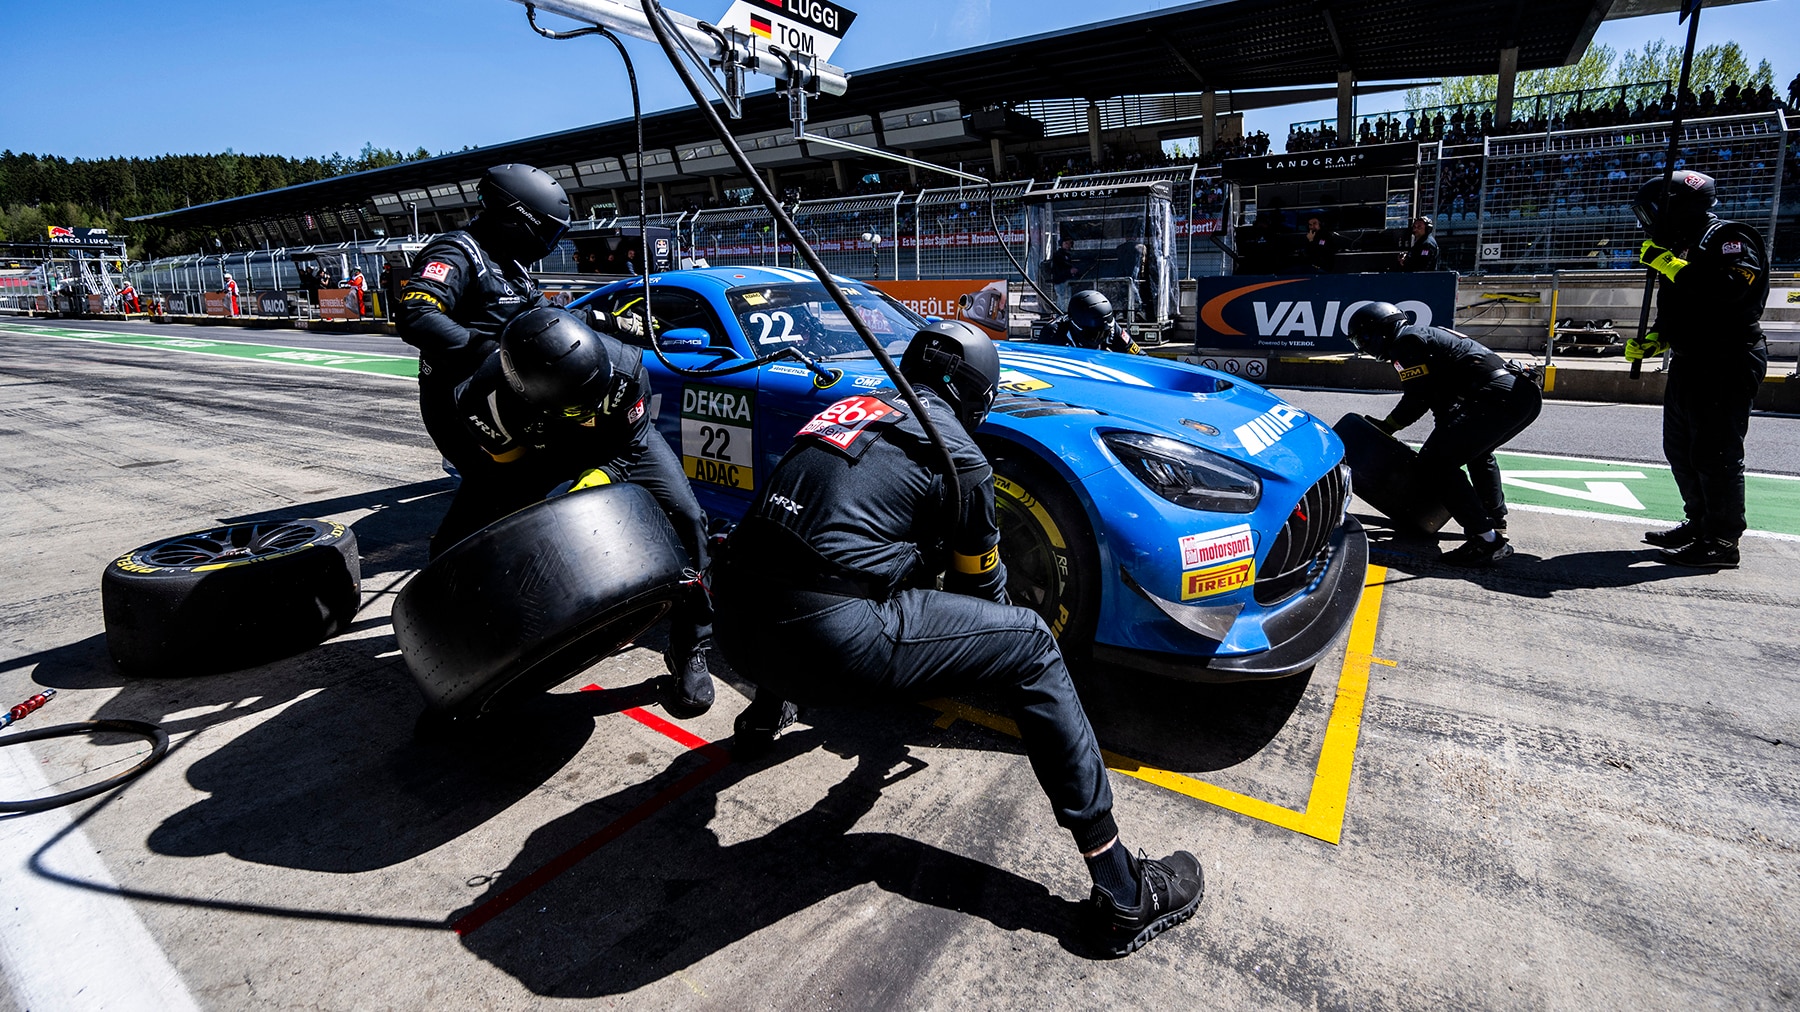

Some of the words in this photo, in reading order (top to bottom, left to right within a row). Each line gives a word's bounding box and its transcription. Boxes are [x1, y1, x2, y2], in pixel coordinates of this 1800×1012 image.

[788, 0, 839, 31] LUGGI
[777, 23, 814, 55] TOM
[1484, 247, 1499, 256] 03
[169, 300, 184, 311] VAICO
[262, 300, 285, 312] VAICO
[749, 311, 804, 345] 22
[854, 377, 883, 387] OMP
[1400, 368, 1421, 379] DTM
[683, 388, 751, 421] DEKRA
[700, 425, 732, 462] 22
[805, 421, 846, 441] bilstein
[695, 459, 740, 487] ADAC
[769, 493, 803, 514] HRX
[1199, 535, 1250, 562] motorsport
[1188, 564, 1249, 595] PIRELLI
